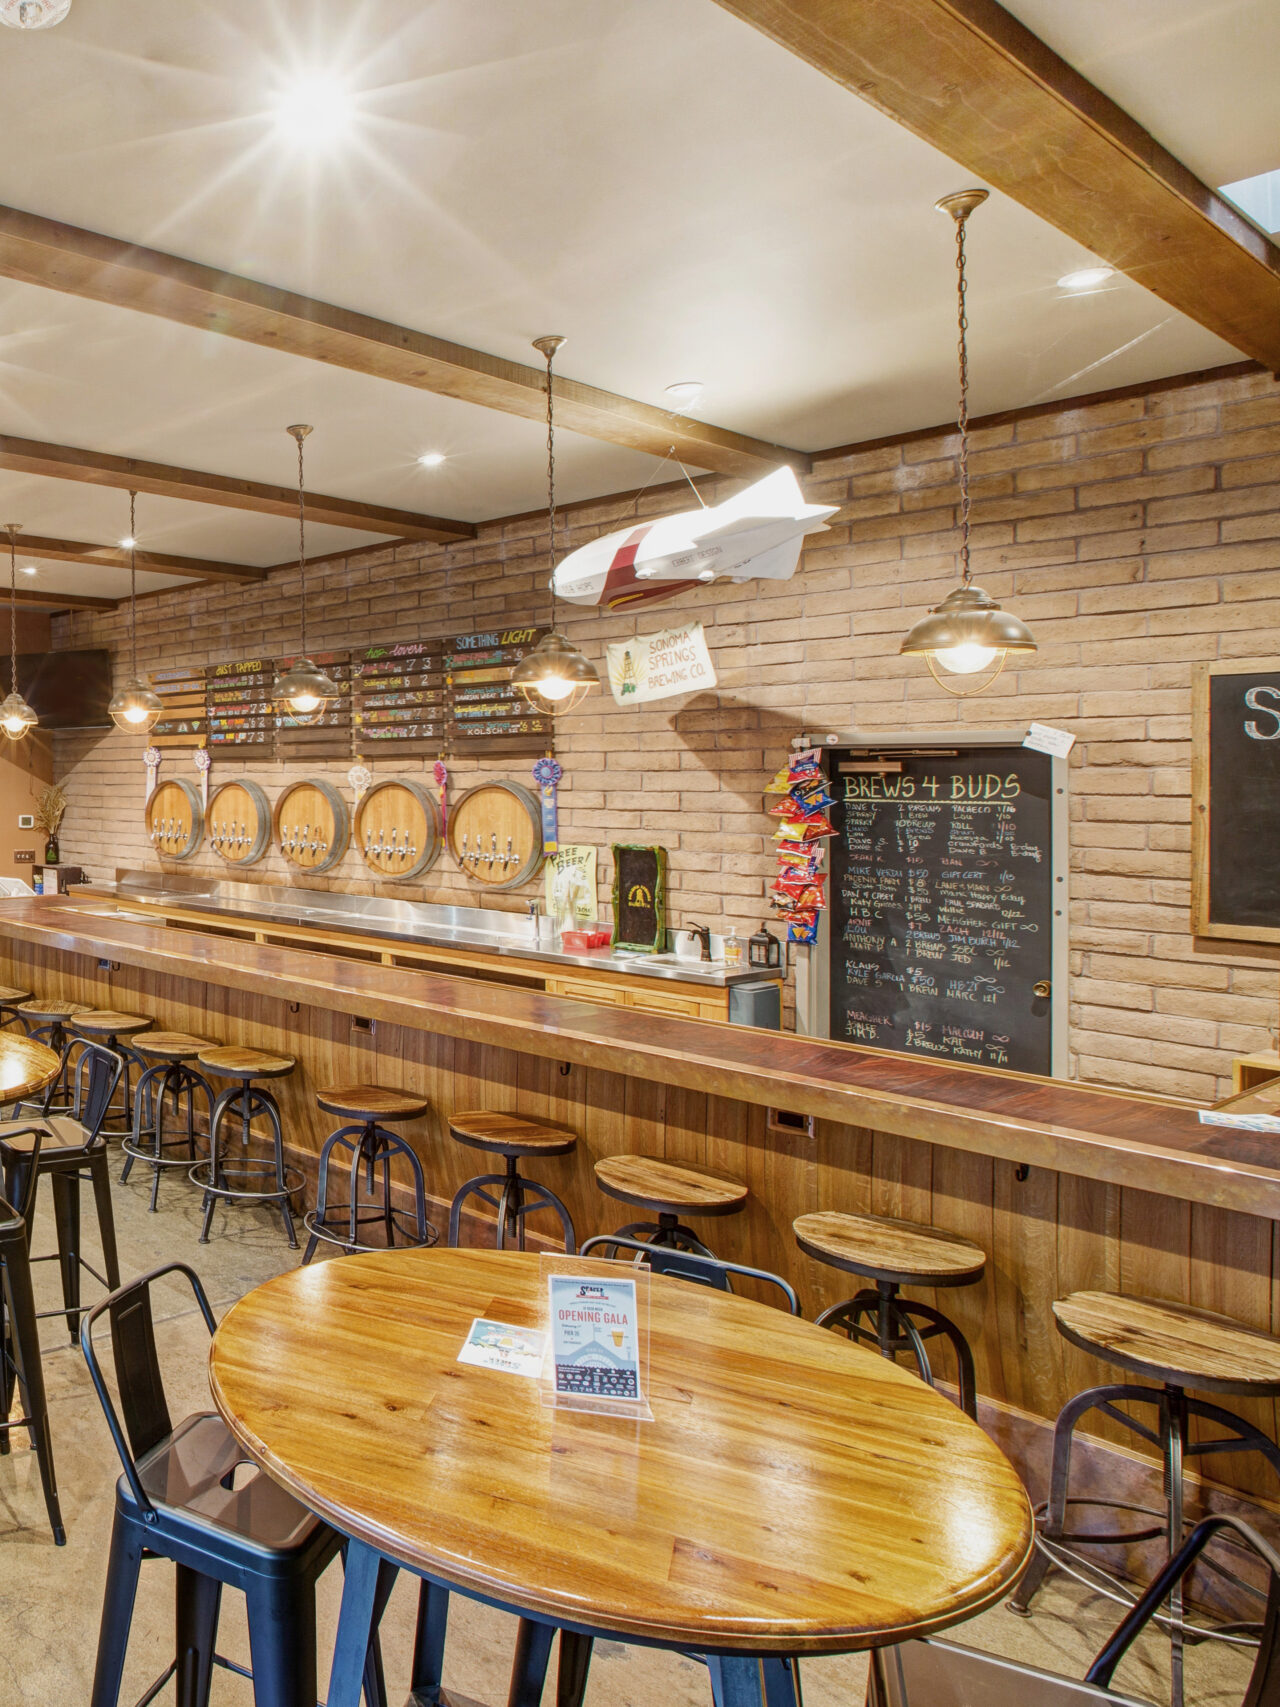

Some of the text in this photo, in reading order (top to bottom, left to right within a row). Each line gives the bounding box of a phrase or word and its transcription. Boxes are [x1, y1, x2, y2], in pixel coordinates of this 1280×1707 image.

[456, 629, 536, 650] SOMETHING LIGHT
[649, 631, 691, 654] SONOMA
[389, 643, 428, 656] lovers
[648, 645, 696, 670] SPRINGS
[216, 660, 262, 676] JUST TAPPED
[648, 668, 688, 689] BREWING
[843, 774, 1020, 799] BREWS 4 BUDS
[848, 866, 871, 875] MIKE
[992, 921, 1018, 930] GIFT
[846, 960, 880, 971] KLAUS
[950, 954, 973, 964] JED
[848, 968, 870, 978] KYLE
[846, 976, 869, 986] DAVE
[908, 984, 939, 996] BREW
[558, 1309, 601, 1323] OPENING
[603, 1312, 629, 1326] GALA
